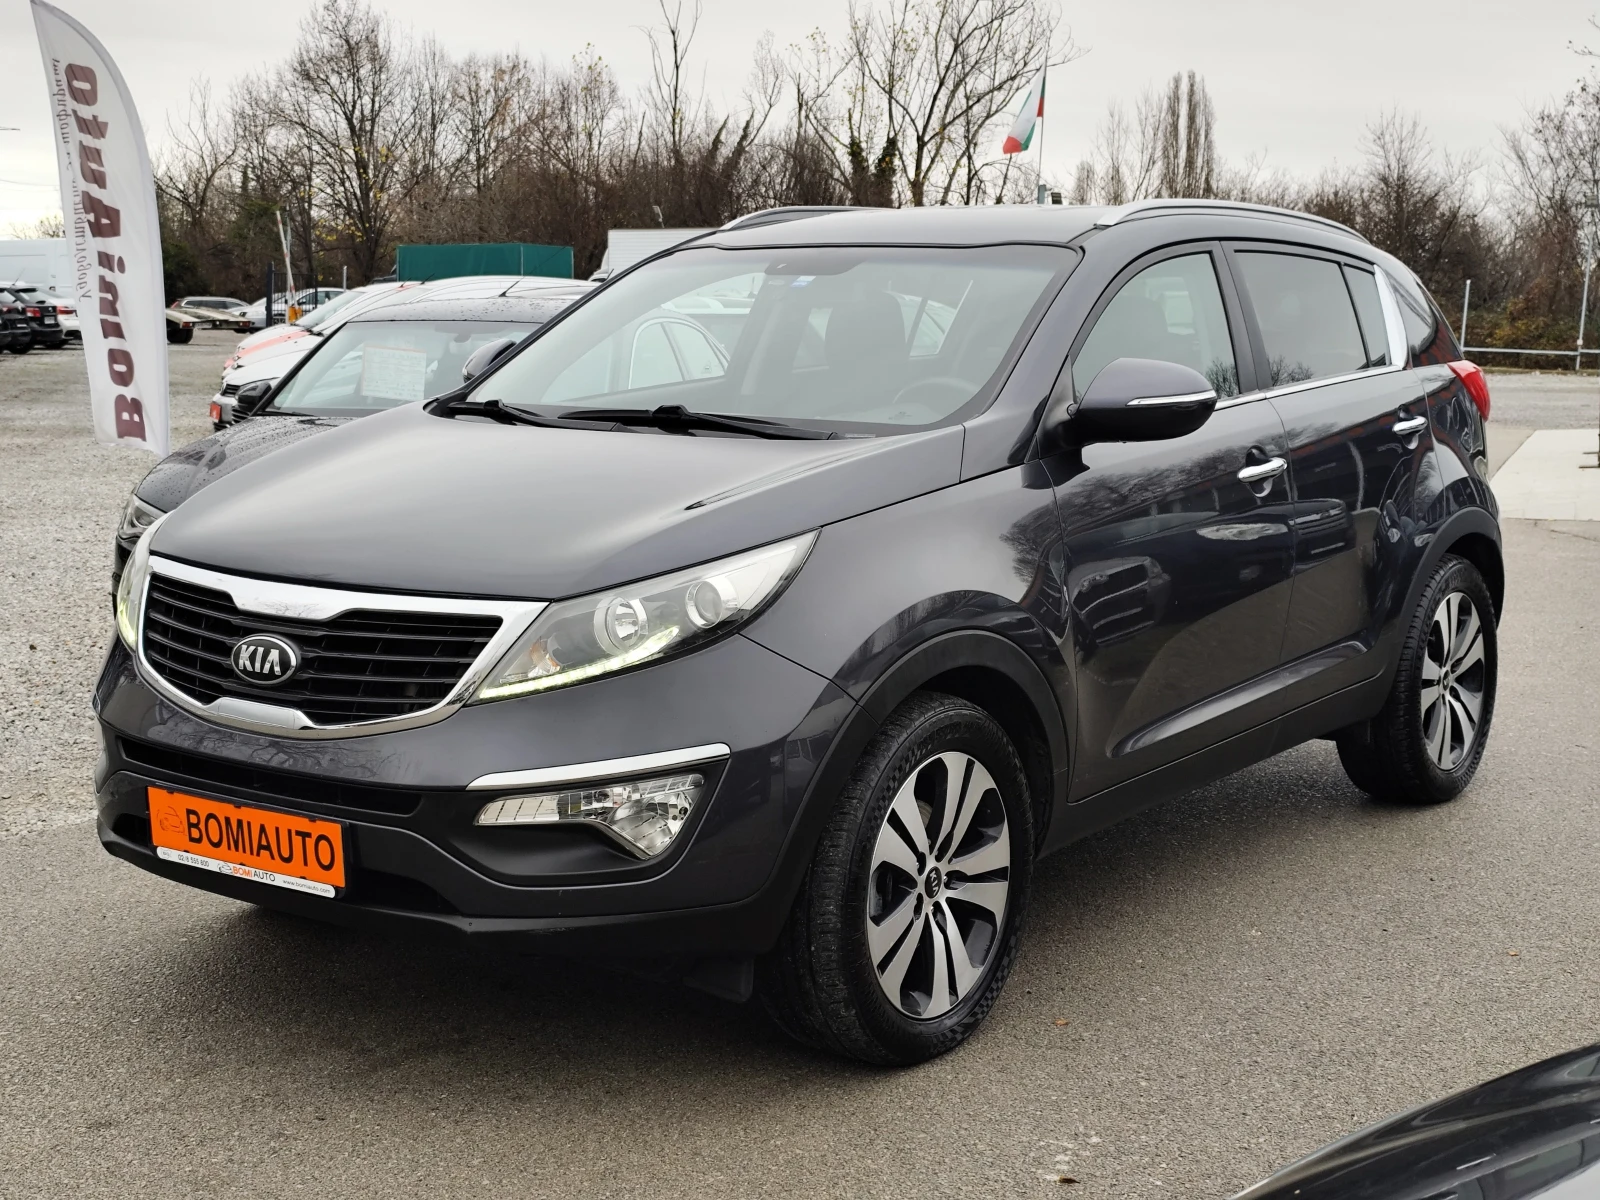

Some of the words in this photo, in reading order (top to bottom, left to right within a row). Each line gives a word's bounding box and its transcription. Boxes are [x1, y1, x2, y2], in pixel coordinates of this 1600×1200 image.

[239, 644, 281, 675] KIA
[186, 808, 335, 872] BOMIAUTO
[282, 879, 331, 894] www.bomiauto.com
